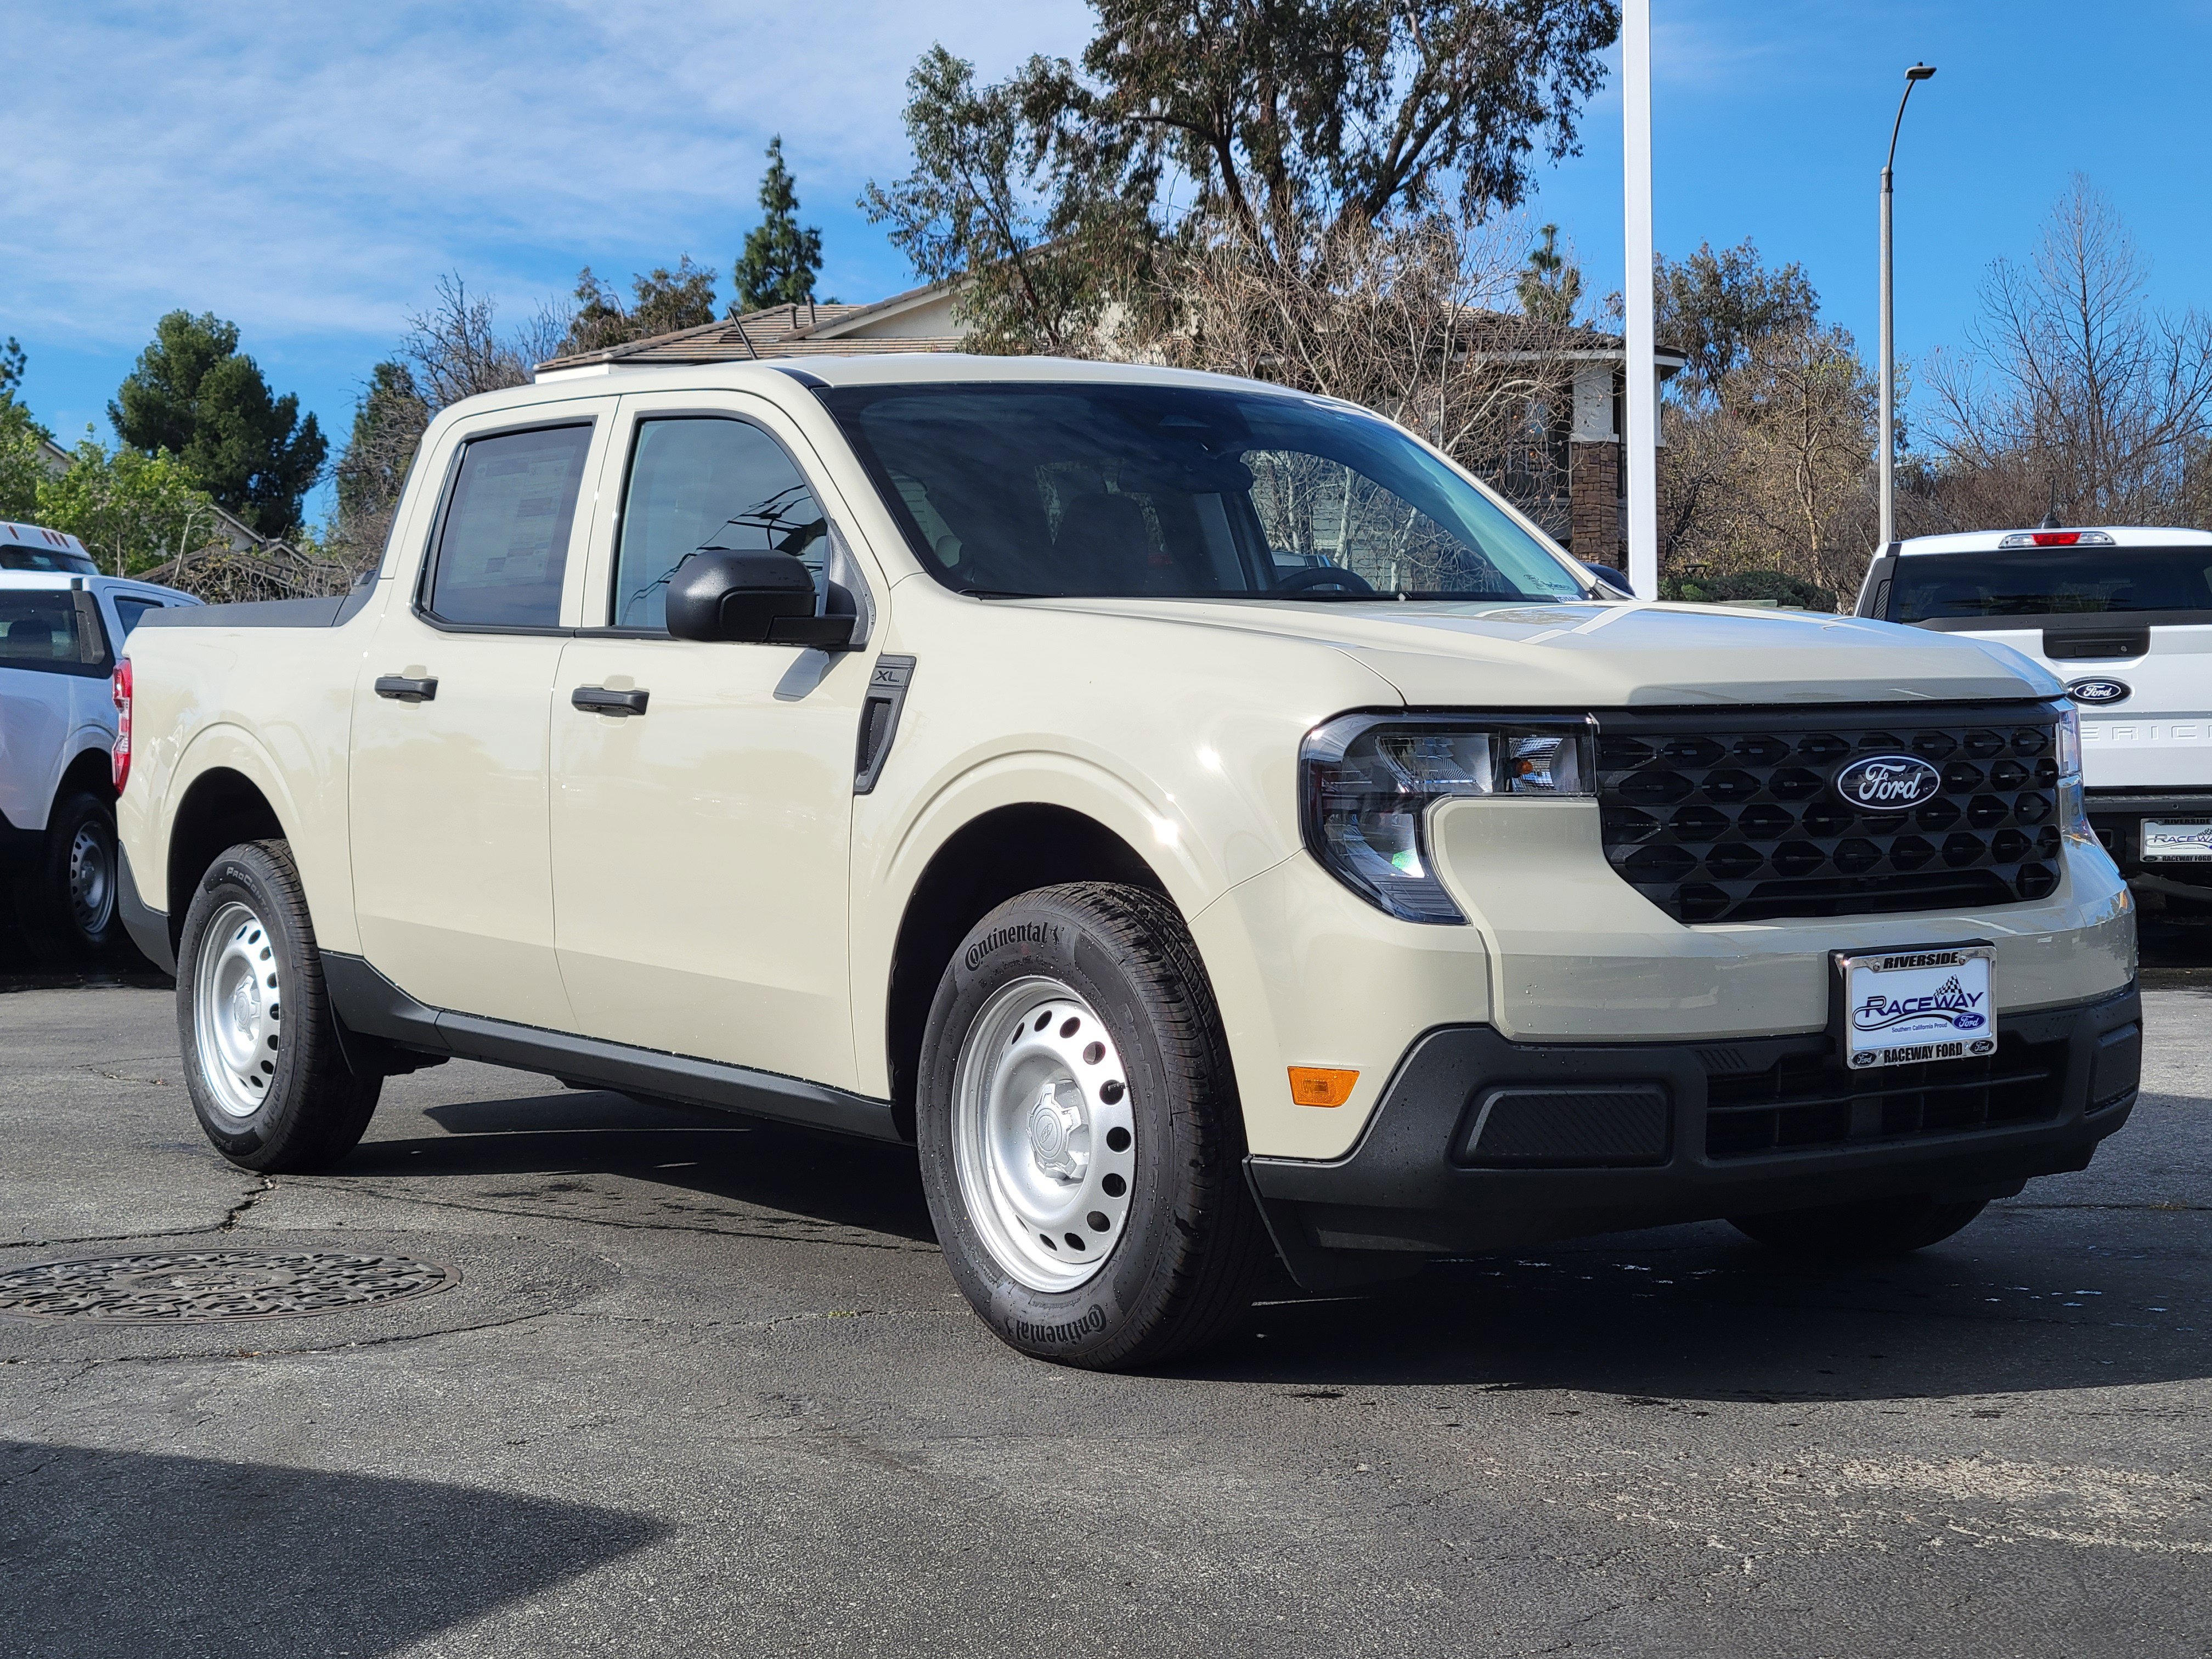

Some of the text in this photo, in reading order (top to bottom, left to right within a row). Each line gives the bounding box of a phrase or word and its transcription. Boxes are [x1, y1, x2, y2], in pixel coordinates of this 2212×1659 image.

[874, 670, 900, 682] XL
[2083, 684, 2112, 697] Ford
[1858, 763, 1922, 801] Ford
[964, 921, 1048, 972] Continental
[1883, 951, 1959, 969] RIVERSIDE
[1865, 991, 1985, 1018] RACEWAY
[1912, 1023, 1933, 1031] California
[1958, 1015, 1979, 1027] Ford
[1883, 1042, 1963, 1063] RACEWAY FORD
[1974, 1041, 1990, 1053] Ford
[1856, 1053, 1872, 1064] Ford
[1015, 1304, 1107, 1346] Continental
